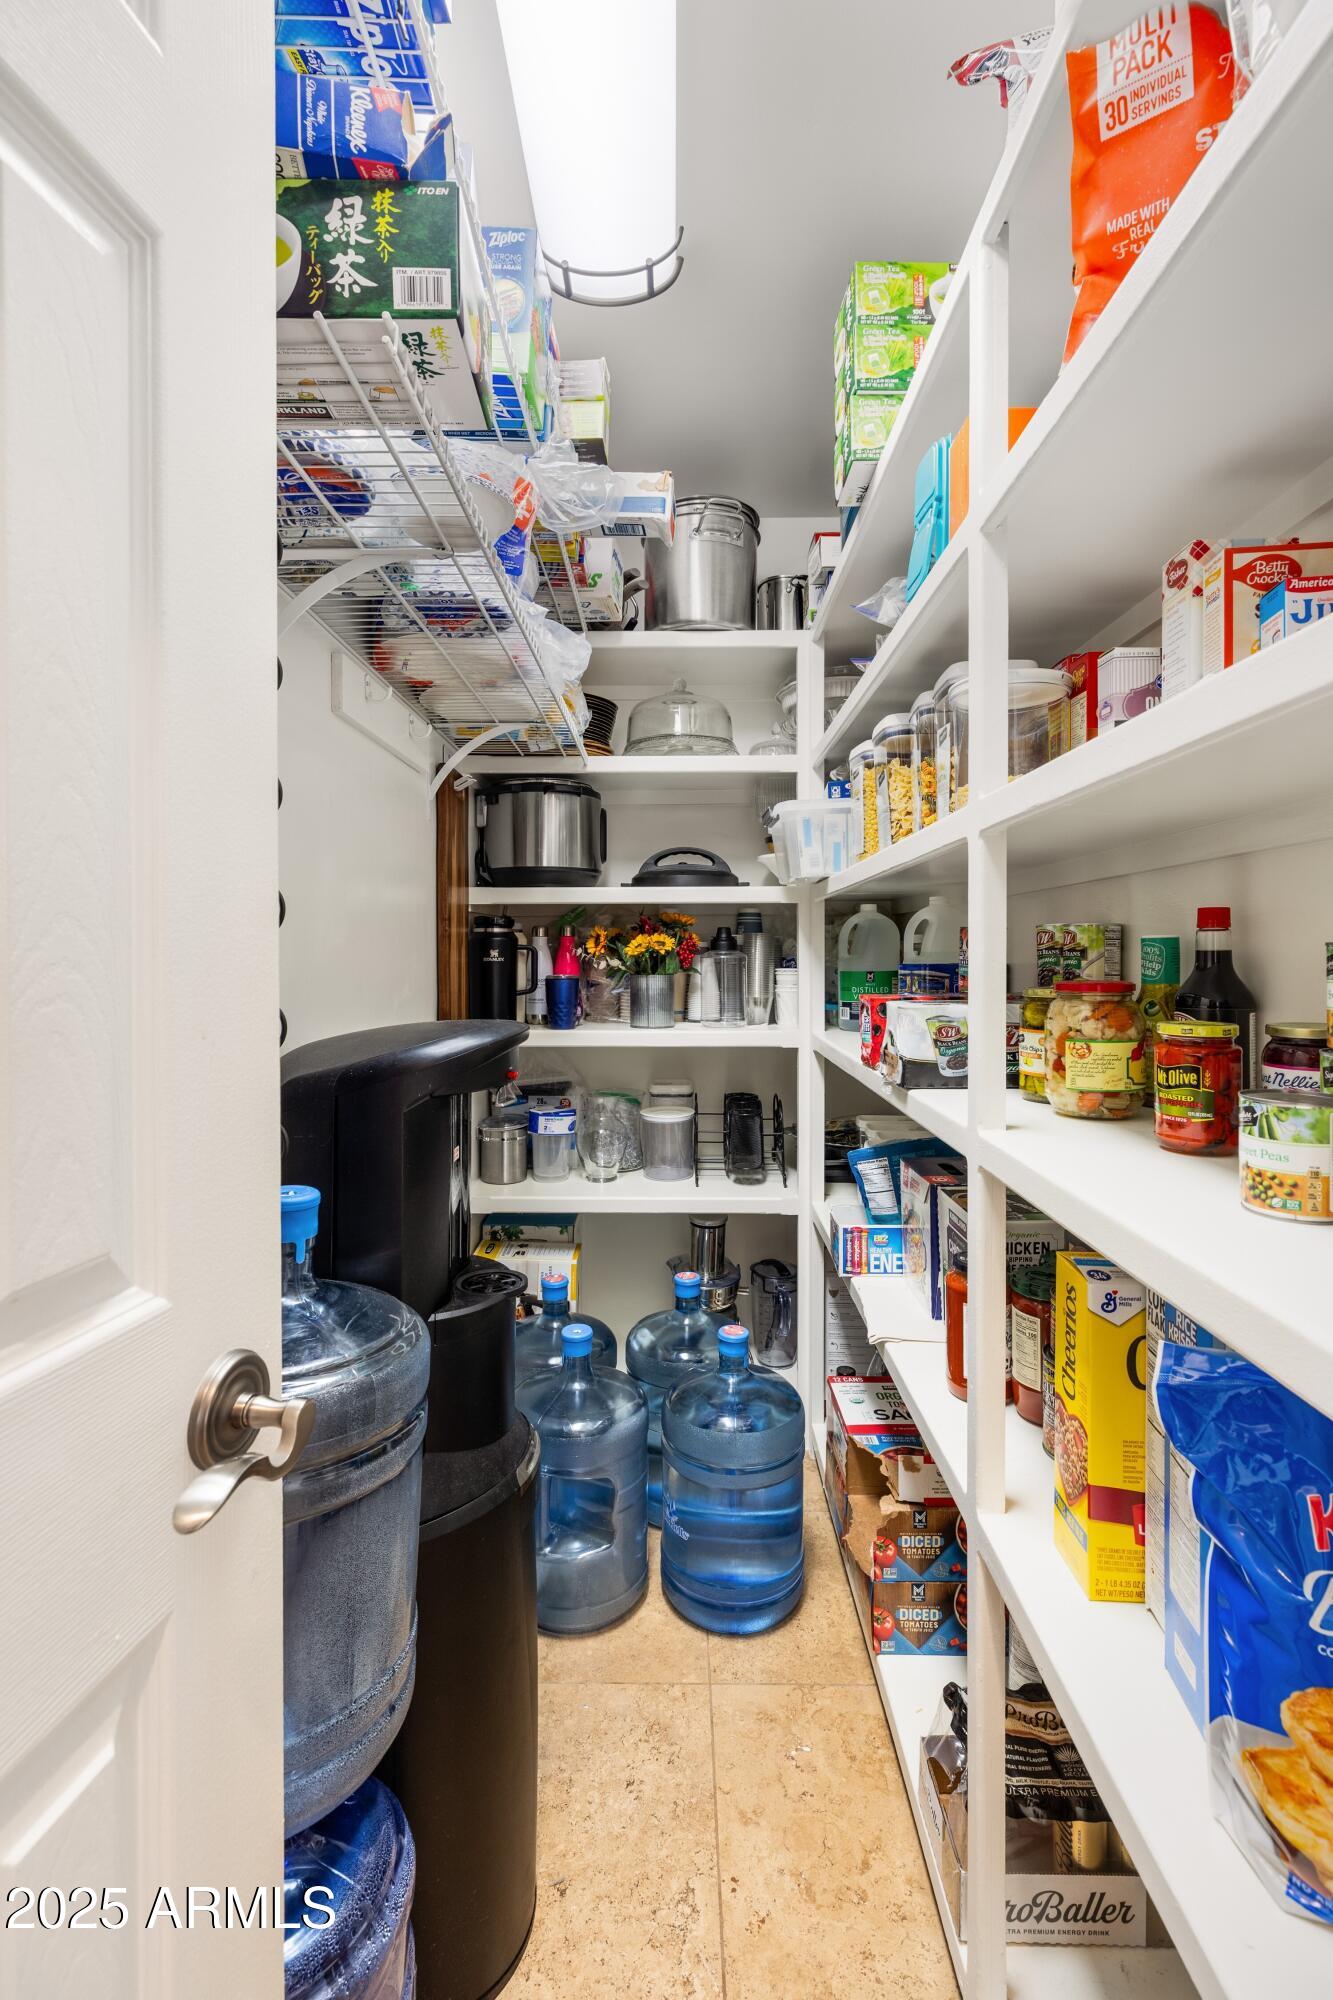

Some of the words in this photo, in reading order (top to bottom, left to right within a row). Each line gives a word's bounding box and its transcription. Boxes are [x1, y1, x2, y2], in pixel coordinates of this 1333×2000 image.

[1113, 30, 1173, 86] PACK
[303, 77, 317, 109] Dinner
[1130, 66, 1188, 104] INDIVIDUAL
[1104, 96, 1129, 131] 30
[1131, 86, 1182, 120] SERVINGS
[303, 109, 317, 147] Napkins
[347, 86, 373, 154] Kleenex
[417, 187, 435, 196] ITO
[435, 187, 449, 196] EN
[369, 188, 402, 263] 抹茶入り
[1106, 209, 1138, 236] MADE
[1139, 196, 1170, 221] WITH
[1130, 218, 1156, 241] REAL
[322, 195, 379, 298] 緑茶
[488, 231, 526, 247] Ziploc
[1251, 560, 1290, 575] Betty
[1168, 1069, 1198, 1086] Olive
[1160, 1092, 1194, 1102] ROASTED
[1260, 1148, 1290, 1163] Peas
[1175, 1309, 1197, 1343] RICE
[1061, 1282, 1077, 1401] Cheerios
[901, 1535, 941, 1548] DICED
[1095, 1589, 1106, 1597] NET
[1110, 1580, 1118, 1588] LB
[1133, 1581, 1141, 1589] OZ
[899, 1609, 939, 1621] DICED
[1040, 1788, 1089, 1797] PREMIUM
